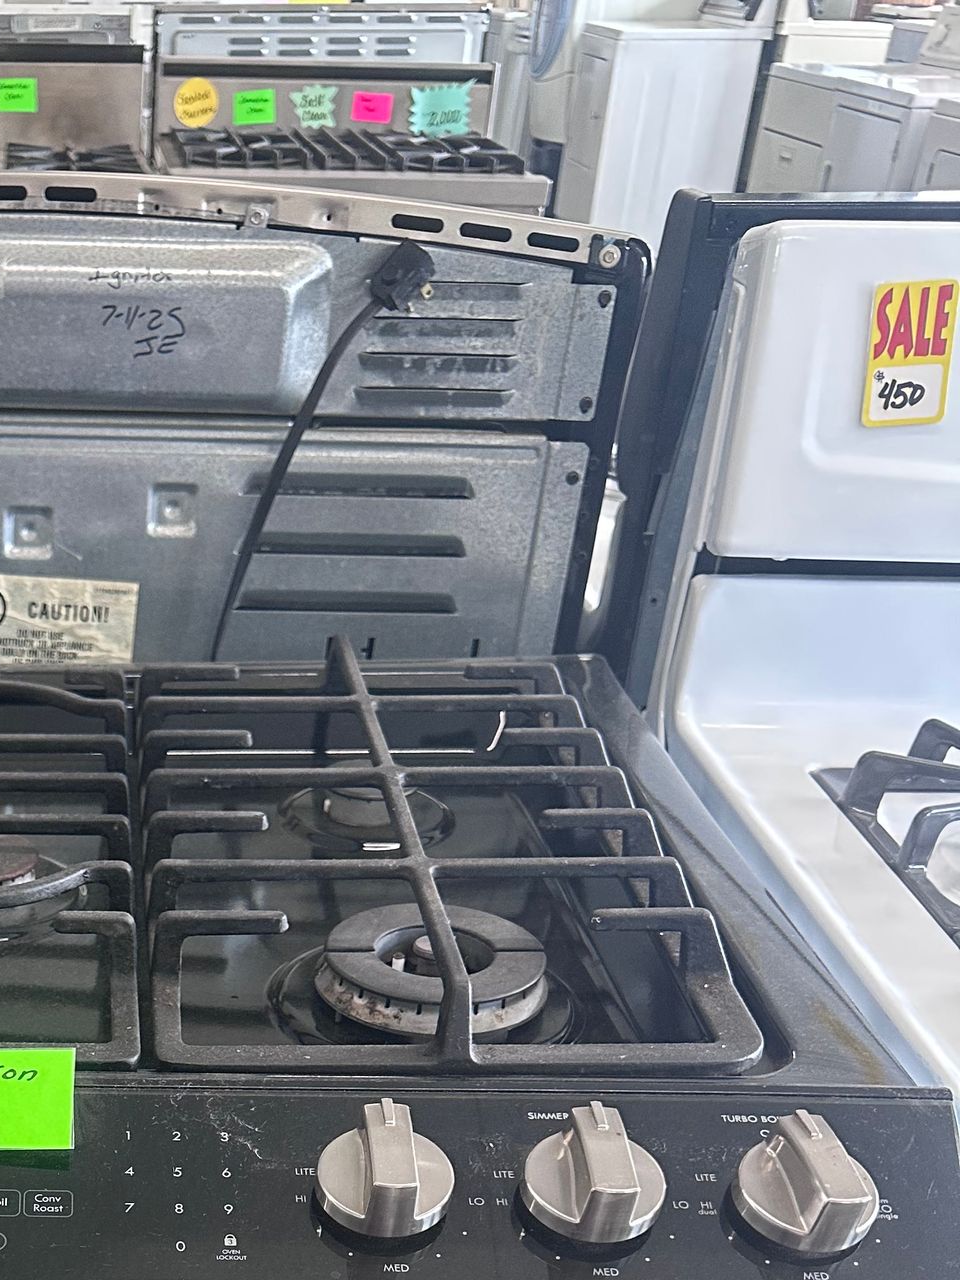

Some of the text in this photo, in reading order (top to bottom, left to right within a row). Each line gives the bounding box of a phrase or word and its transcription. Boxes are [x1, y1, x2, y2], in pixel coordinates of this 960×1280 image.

[874, 284, 954, 360] SALE
[28, 602, 110, 623] CAUTION!
[720, 1114, 758, 1123] TURBO
[125, 1131, 131, 1141] 1
[172, 1131, 182, 1142] 2
[124, 1166, 135, 1176] 4
[173, 1167, 182, 1177] 5
[222, 1168, 232, 1178] 6
[295, 1167, 316, 1176] LITE
[494, 1171, 516, 1179] LITE
[695, 1173, 718, 1182] LITE
[34, 1193, 62, 1203] Conv
[295, 1195, 307, 1203] HI
[469, 1198, 485, 1206] LO
[496, 1198, 508, 1206] HI
[33, 1203, 64, 1213] Roast
[124, 1202, 135, 1213] 7
[174, 1203, 184, 1214] 8
[223, 1204, 234, 1215] 9
[673, 1201, 689, 1209] LO
[700, 1202, 713, 1210] HI
[383, 1264, 410, 1273] MED
[593, 1268, 619, 1277] MED
[803, 1272, 830, 1280] MED
